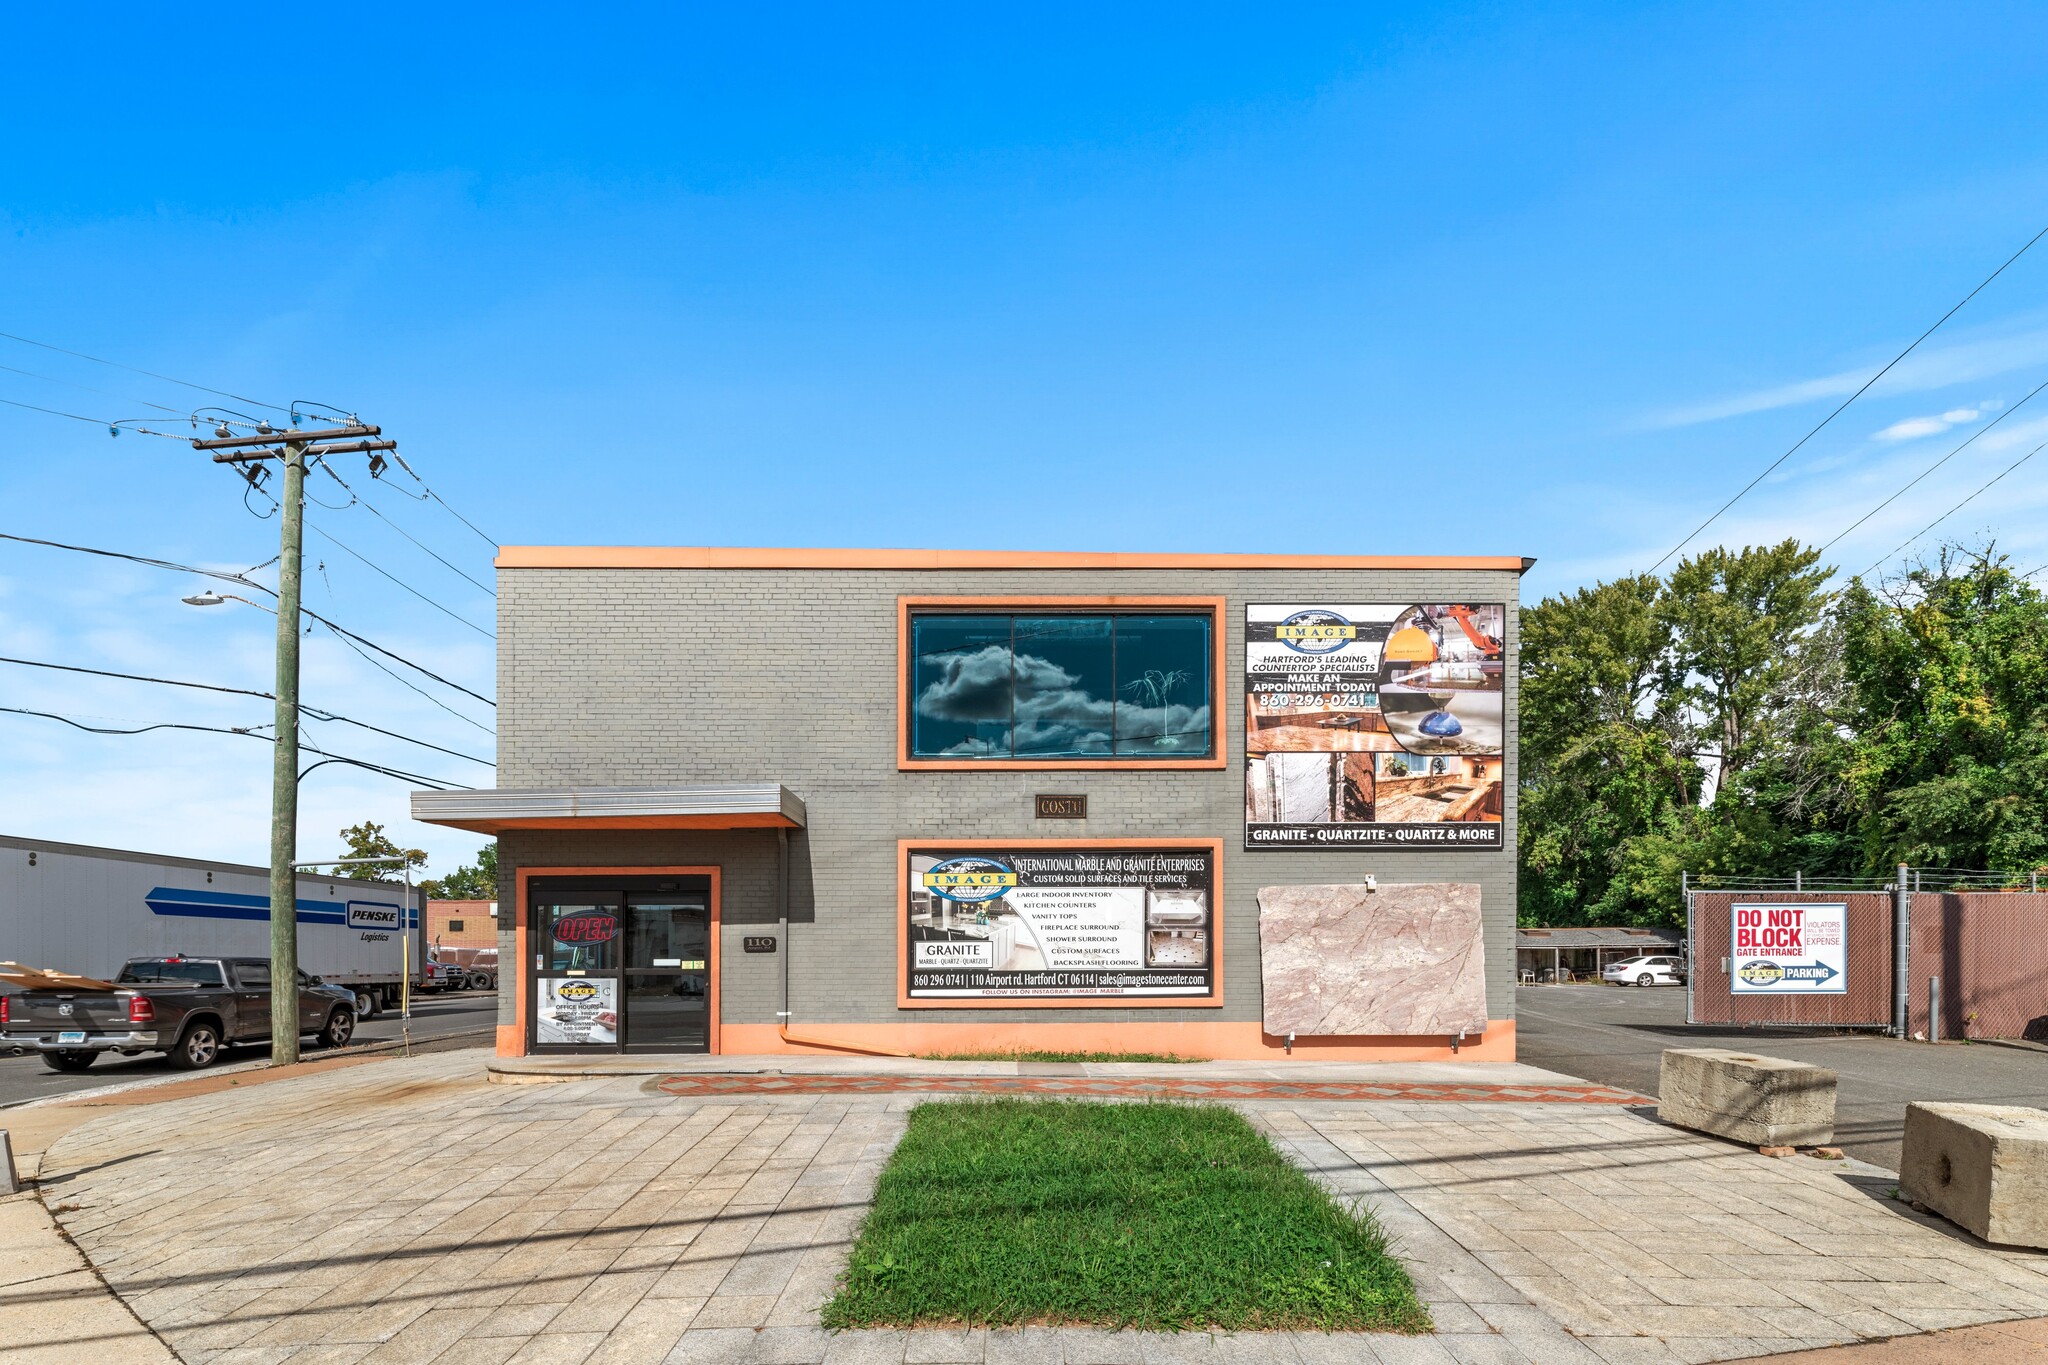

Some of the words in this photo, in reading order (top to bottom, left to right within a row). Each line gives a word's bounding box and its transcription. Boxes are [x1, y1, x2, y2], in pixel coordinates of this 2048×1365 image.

[1285, 628, 1347, 636] IMAGE
[1252, 664, 1317, 672] COUNTERTOP
[1319, 664, 1376, 672] SPECIALISTS
[1287, 674, 1320, 682] MAKE
[1323, 674, 1340, 682] AN
[1253, 683, 1331, 692] APPOINTMENT
[1336, 683, 1376, 692] TODAY!
[1260, 694, 1366, 706] 860-296-0741
[1253, 830, 1307, 840] GRANITE
[1316, 830, 1385, 841] QUARTZITE
[1395, 830, 1445, 841] QUARTZ
[1447, 830, 1457, 840] &
[1459, 830, 1495, 840] MORE
[1015, 859, 1073, 871] INTERNATIONAL
[1074, 859, 1104, 871] MARBLE
[1105, 859, 1122, 871] AND
[1123, 859, 1155, 871] GRANITE
[1157, 858, 1205, 871] ENTERPRISES
[934, 875, 1007, 883] IMAGE
[1033, 874, 1064, 883] CUSTOM
[1065, 874, 1086, 883] SOLID
[1087, 874, 1122, 883] SURFACES
[1122, 874, 1137, 883] AND
[1139, 874, 1153, 883] TILE
[1154, 874, 1187, 883] SERVICES
[352, 910, 396, 922] PENSKE
[1737, 910, 1762, 927] DO
[1768, 910, 1803, 927] NOT
[558, 917, 614, 940] OPEN
[360, 932, 389, 942] Logistics
[746, 938, 772, 946] 110
[1737, 928, 1802, 947] BLOCK
[1806, 937, 1841, 945] EXPENSE.
[926, 945, 980, 955] GRANITE
[1736, 948, 1757, 956] GATE
[1760, 948, 1803, 956] ENTRANCE
[1787, 968, 1829, 978] PARKING
[914, 974, 928, 986] 860
[930, 974, 944, 986] 296
[945, 974, 964, 986] 0741
[971, 974, 984, 985] 110
[985, 973, 1012, 988] Airport
[1013, 973, 1024, 985] rd.
[1024, 973, 1056, 985] Hartford
[1057, 973, 1069, 985] CT
[1070, 973, 1094, 985] 06114
[1098, 972, 1205, 988] sales@imagestonecenter.com
